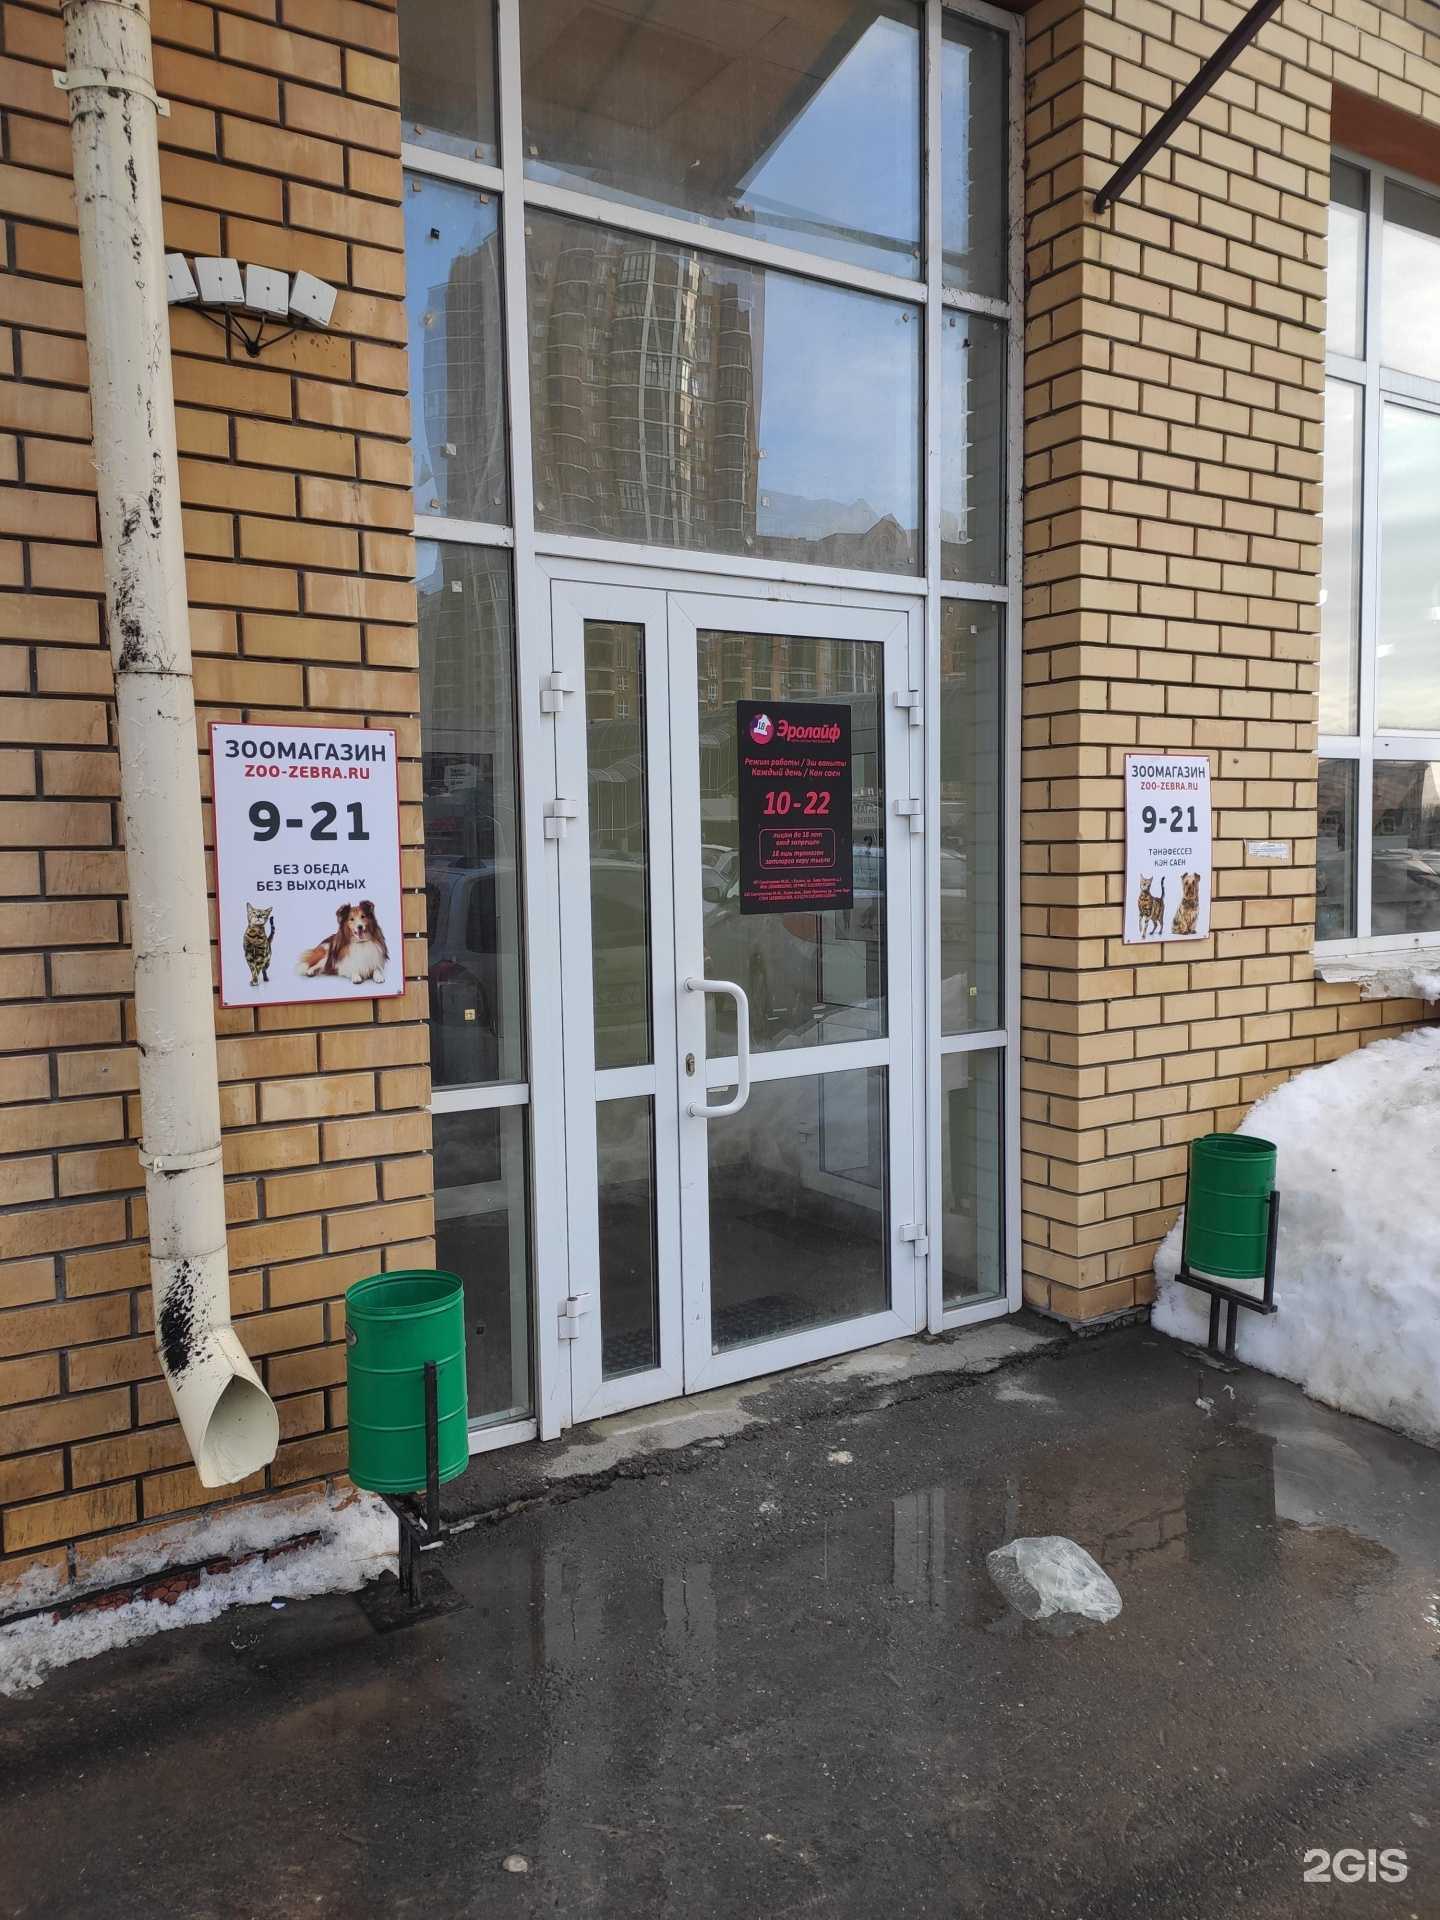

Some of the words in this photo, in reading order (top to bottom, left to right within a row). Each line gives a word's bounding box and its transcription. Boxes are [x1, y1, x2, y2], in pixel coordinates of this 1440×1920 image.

[776, 719, 841, 743] Эролайф
[224, 739, 386, 762] ЗООМАГАЗИН
[770, 757, 800, 768] работы
[244, 764, 370, 780] ZOO-ZEBRA.RU
[751, 767, 783, 777] Каждый
[784, 768, 802, 777] день
[1131, 765, 1206, 778] ЗООМАГАЗИН
[1140, 781, 1199, 791] ZOO-ZEBRA.RU
[248, 800, 370, 842] 9-21
[1142, 805, 1199, 833] 9-21
[1169, 858, 1186, 867] САЕН
[273, 864, 299, 875] БЕЗ
[303, 863, 349, 876] ОБЕДА
[256, 881, 282, 892] БЕЗ
[287, 879, 366, 892] ВЫХОДНЫХ
